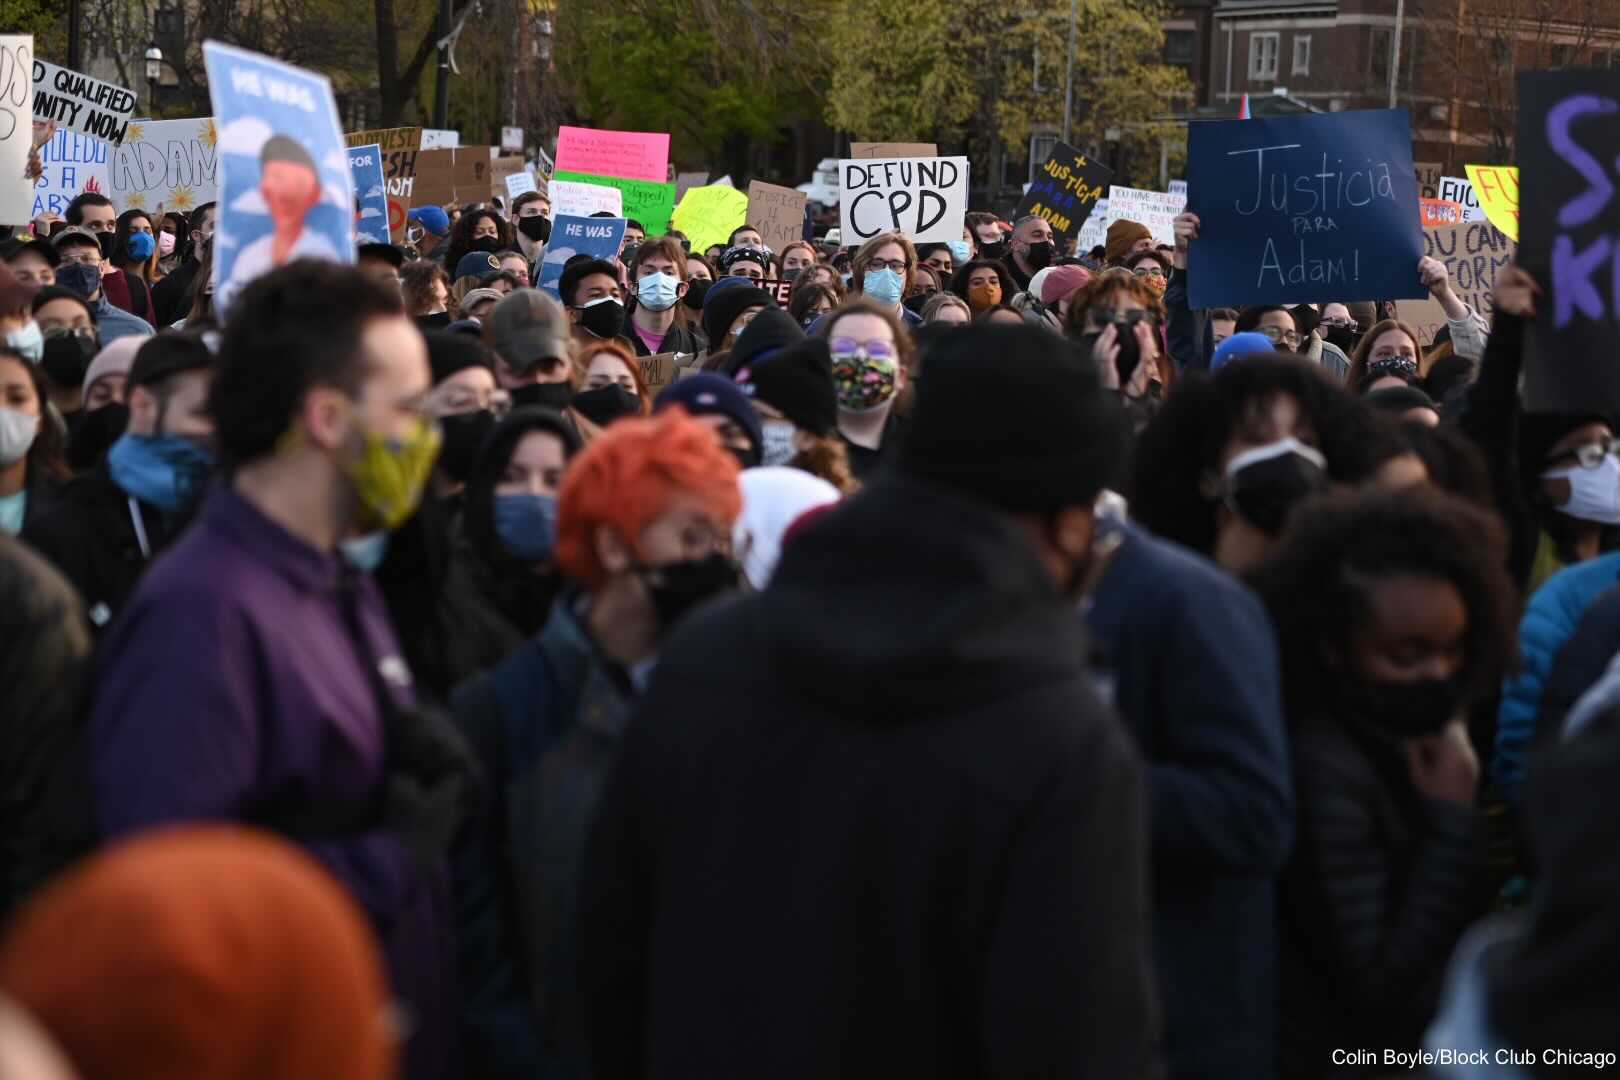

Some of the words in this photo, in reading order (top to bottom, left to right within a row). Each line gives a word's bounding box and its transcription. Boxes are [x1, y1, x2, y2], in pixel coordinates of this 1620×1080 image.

[54, 69, 135, 113] QUALIFIED
[33, 90, 83, 126] NITY
[83, 109, 128, 145] NOW
[61, 167, 75, 189] A
[846, 160, 958, 190] DEFUND
[1043, 158, 1103, 205] JUSTICIA
[1227, 144, 1396, 216] Justicia
[565, 223, 583, 236] HE
[585, 226, 613, 239] WAS
[849, 189, 947, 239] CPD
[1029, 202, 1072, 232] ADAM
[1293, 217, 1338, 234] PARA
[1257, 237, 1359, 288] Adam!
